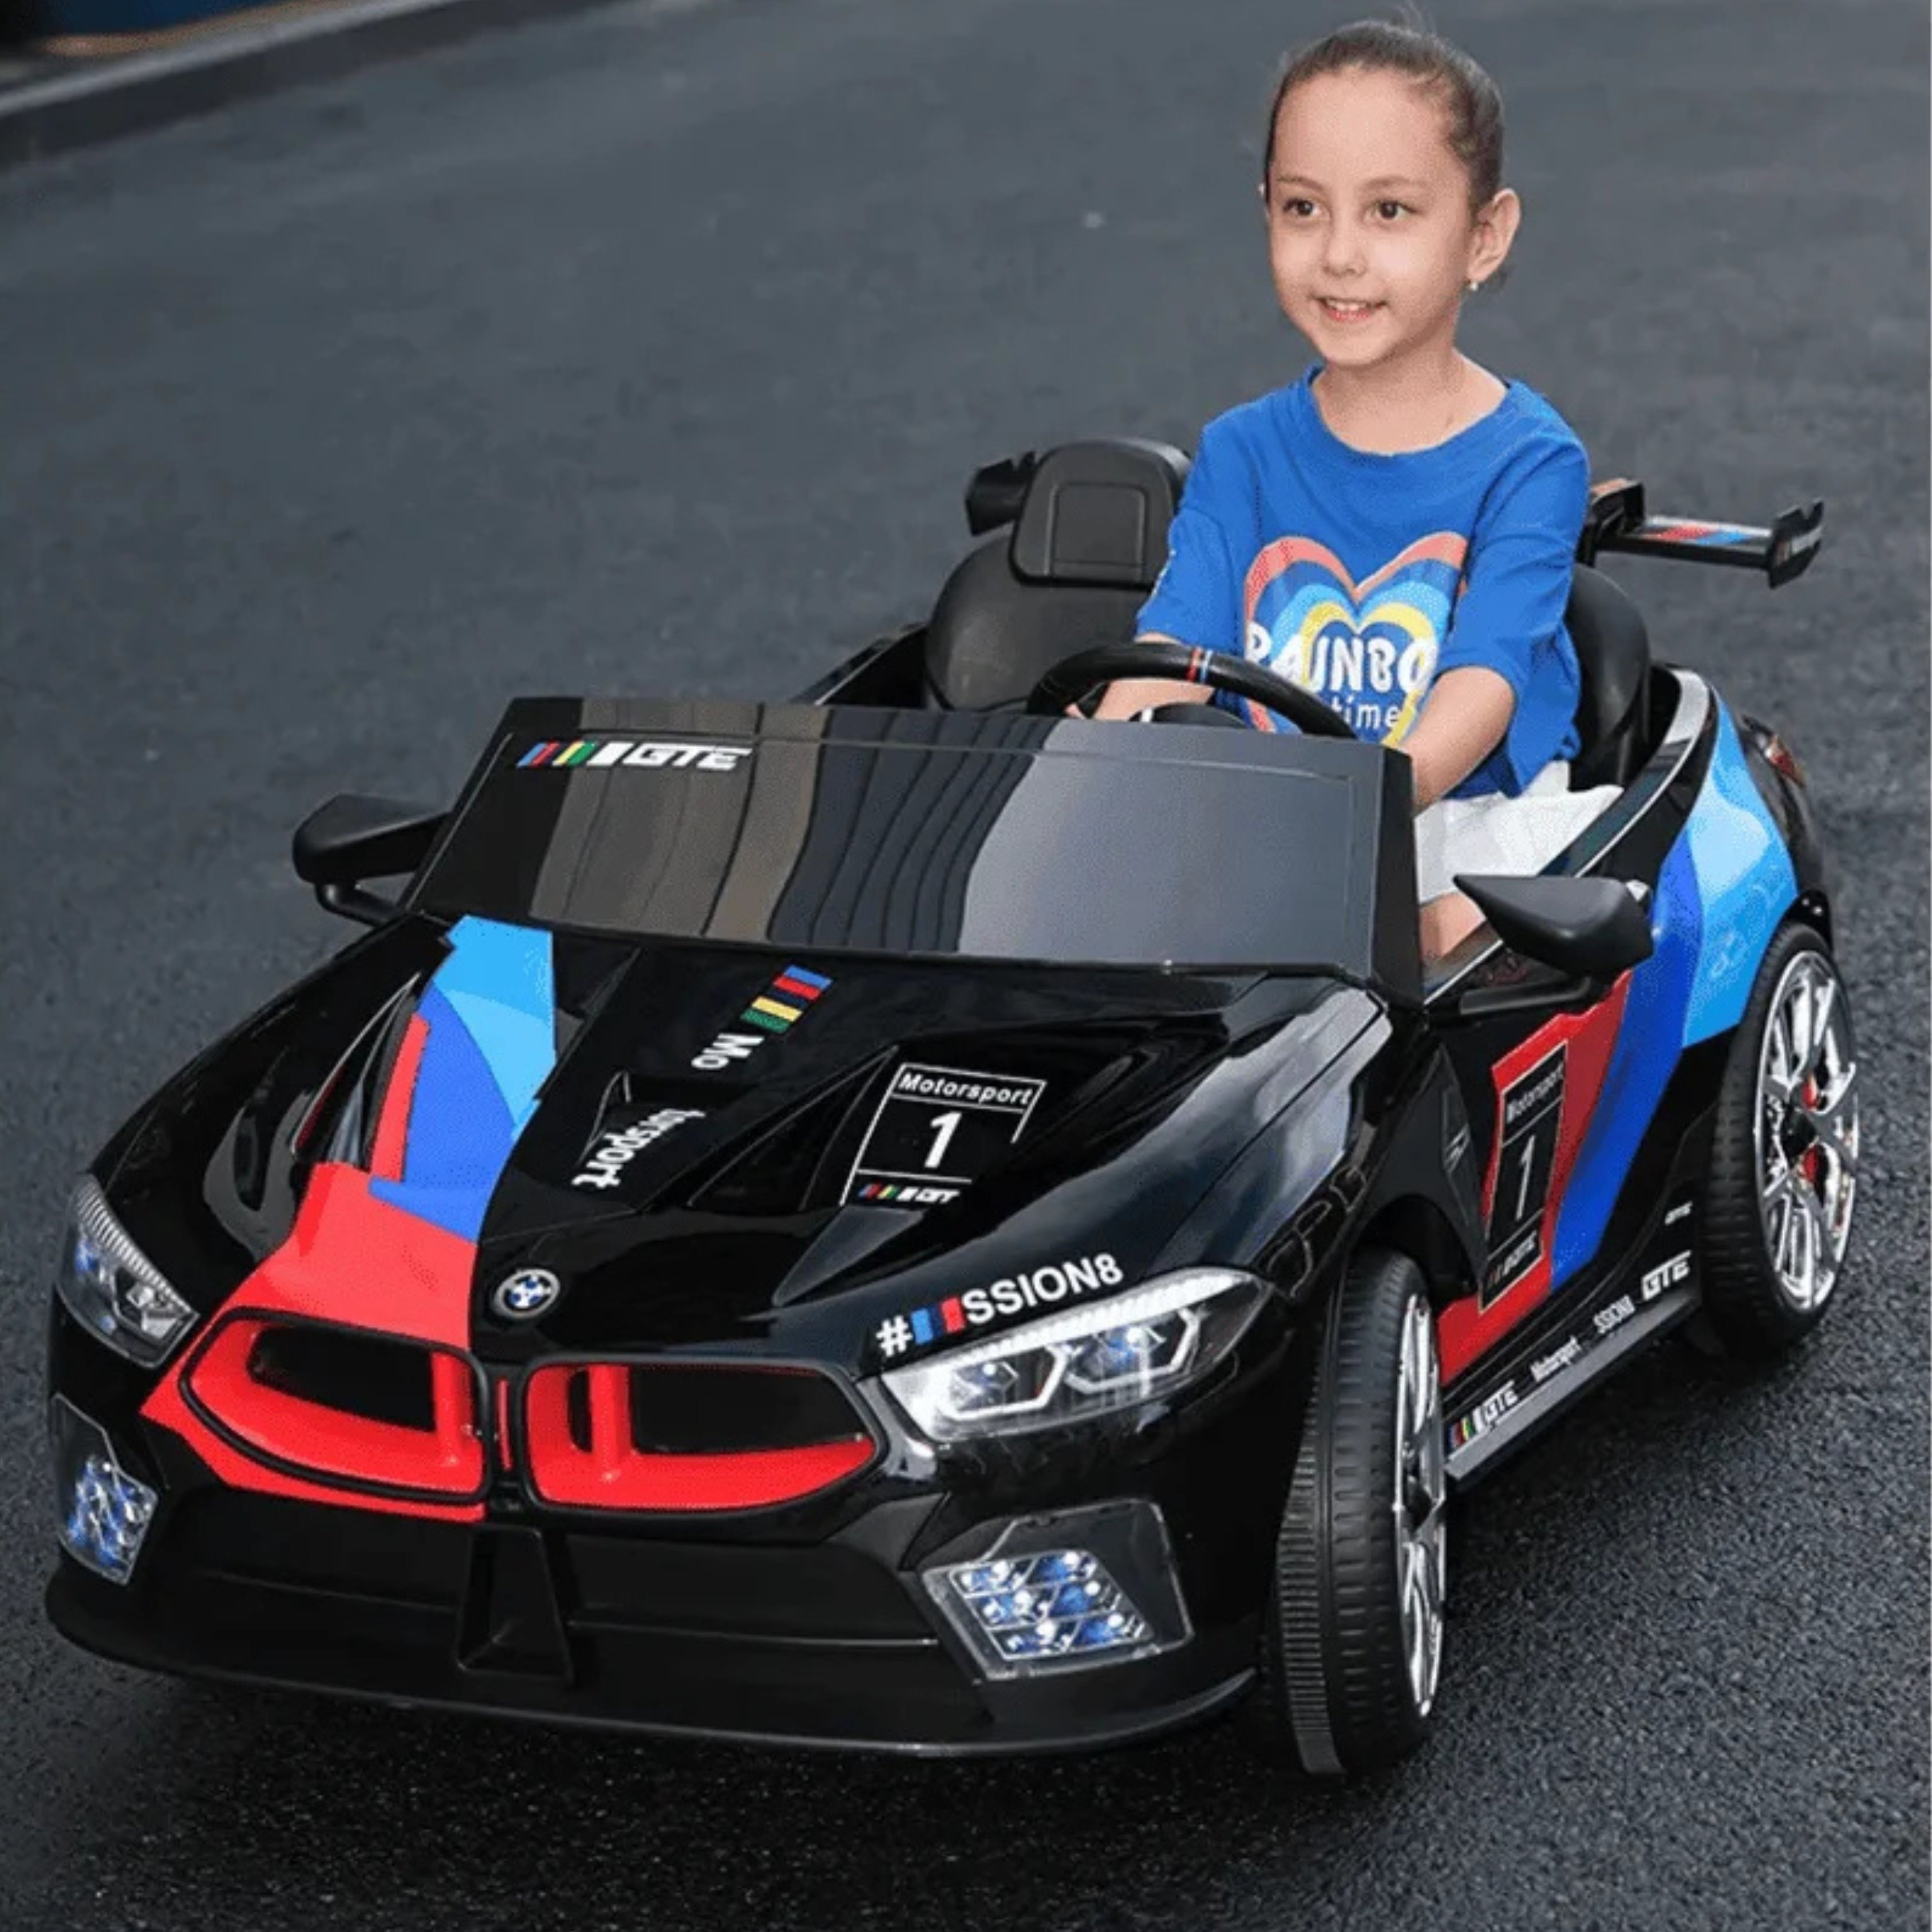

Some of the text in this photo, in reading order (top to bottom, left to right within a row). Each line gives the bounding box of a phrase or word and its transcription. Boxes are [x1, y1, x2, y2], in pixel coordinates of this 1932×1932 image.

[899, 1072, 1032, 1105] Motorsport
[924, 1111, 962, 1169] 1
[1515, 1135, 1535, 1221] 1
[1641, 1249, 1692, 1301] GTE
